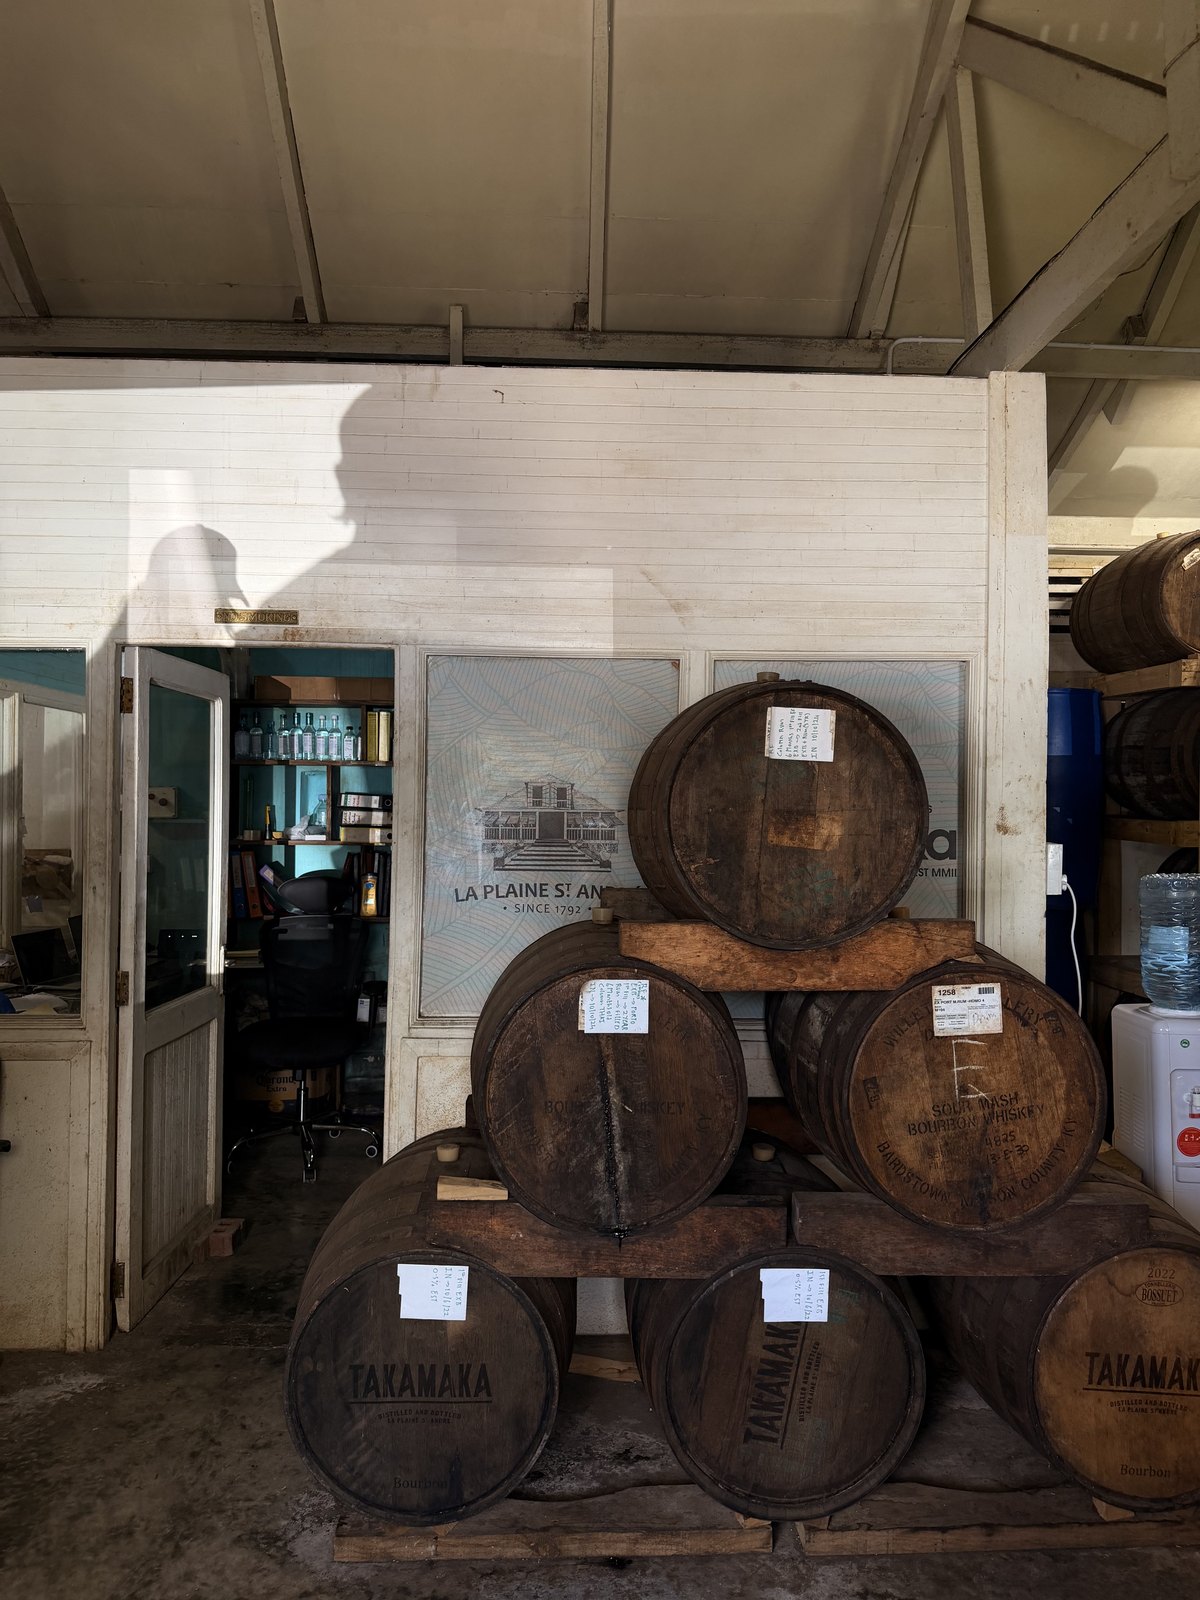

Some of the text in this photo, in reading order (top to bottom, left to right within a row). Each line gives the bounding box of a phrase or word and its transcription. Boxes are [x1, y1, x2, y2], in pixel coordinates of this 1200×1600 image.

[240, 612, 291, 622] SMOKING
[932, 868, 957, 877] MMII
[455, 887, 478, 902] LA
[483, 883, 549, 899] PLAINE
[515, 903, 581, 915] SINCE 1792
[932, 1091, 1018, 1118] SOUR MASH
[908, 1103, 1044, 1136] BOURBON WHISKEY
[1148, 1268, 1175, 1280] 2022
[1142, 1288, 1178, 1302] BOSSUET
[1085, 1352, 1200, 1391] TAKAMAK
[349, 1363, 492, 1398] TAKAMAKA
[743, 1322, 801, 1444] TAKAMAK
[1120, 1464, 1170, 1478] Bourbon
[393, 1477, 448, 1489] Bourbon
